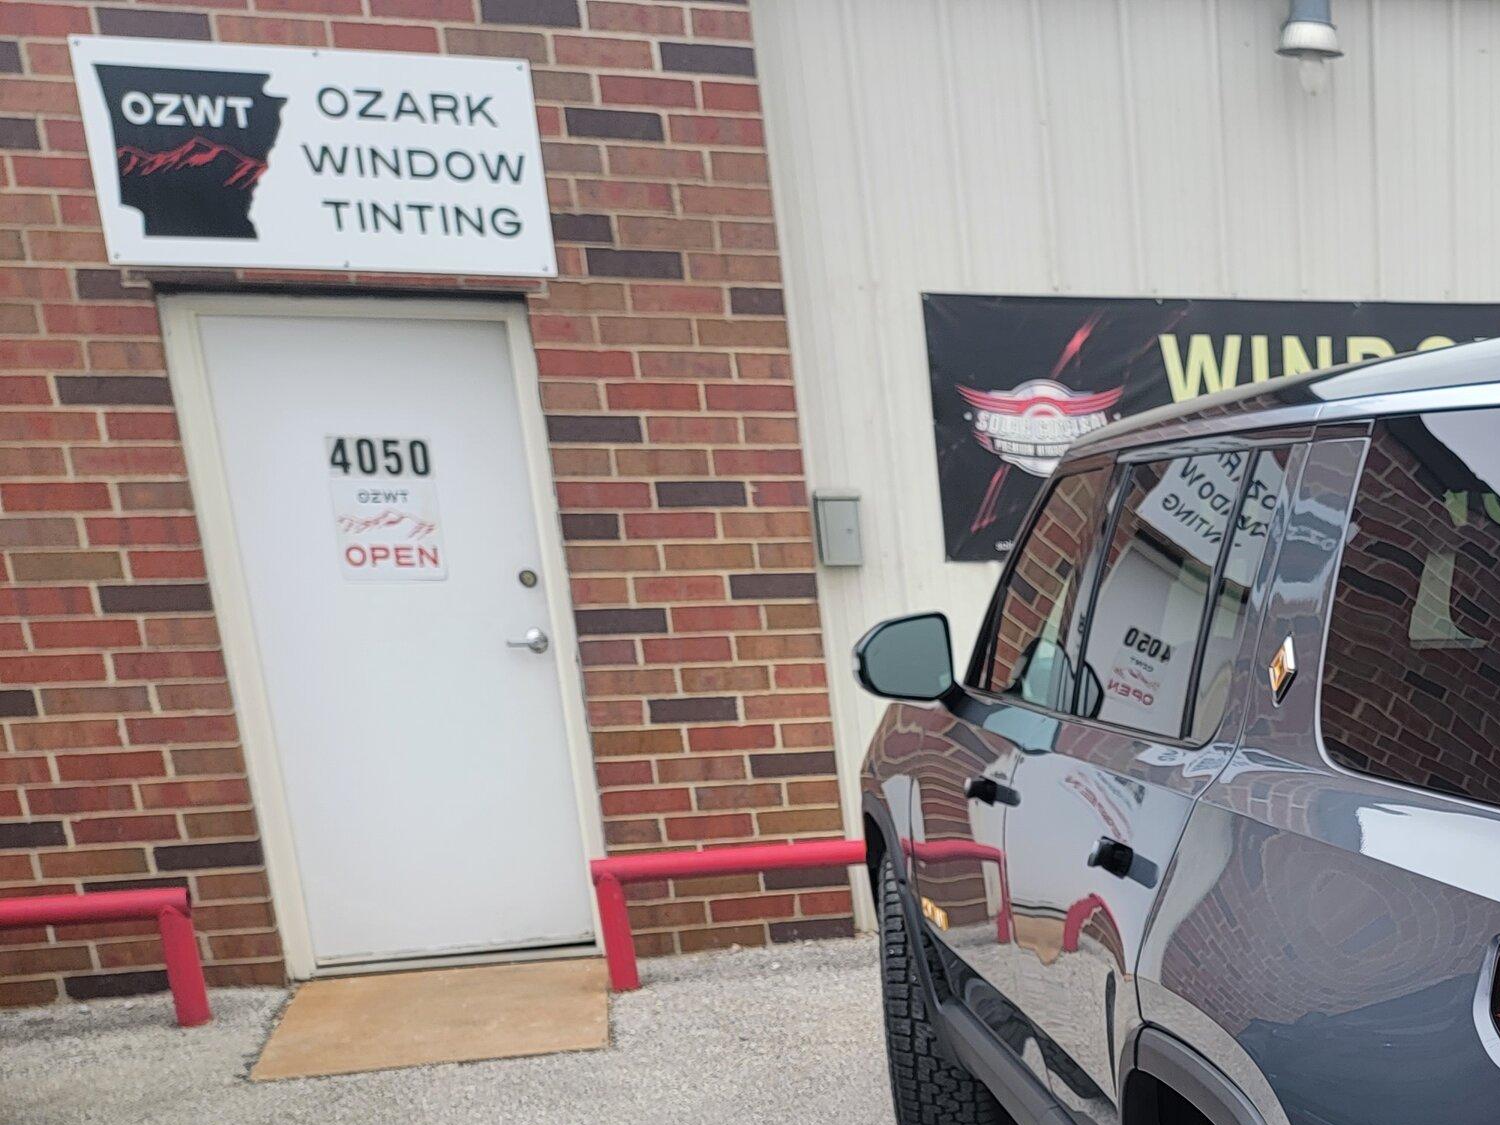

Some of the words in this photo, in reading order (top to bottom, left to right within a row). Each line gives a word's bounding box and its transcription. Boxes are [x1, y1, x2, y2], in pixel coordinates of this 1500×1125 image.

[120, 90, 254, 129] OZWT
[315, 86, 499, 128] OZARK
[300, 143, 526, 185] WINDOW
[321, 200, 524, 239] TINTING
[329, 437, 431, 476] 4050
[357, 489, 410, 504] OZWT
[345, 545, 440, 568] OPEN
